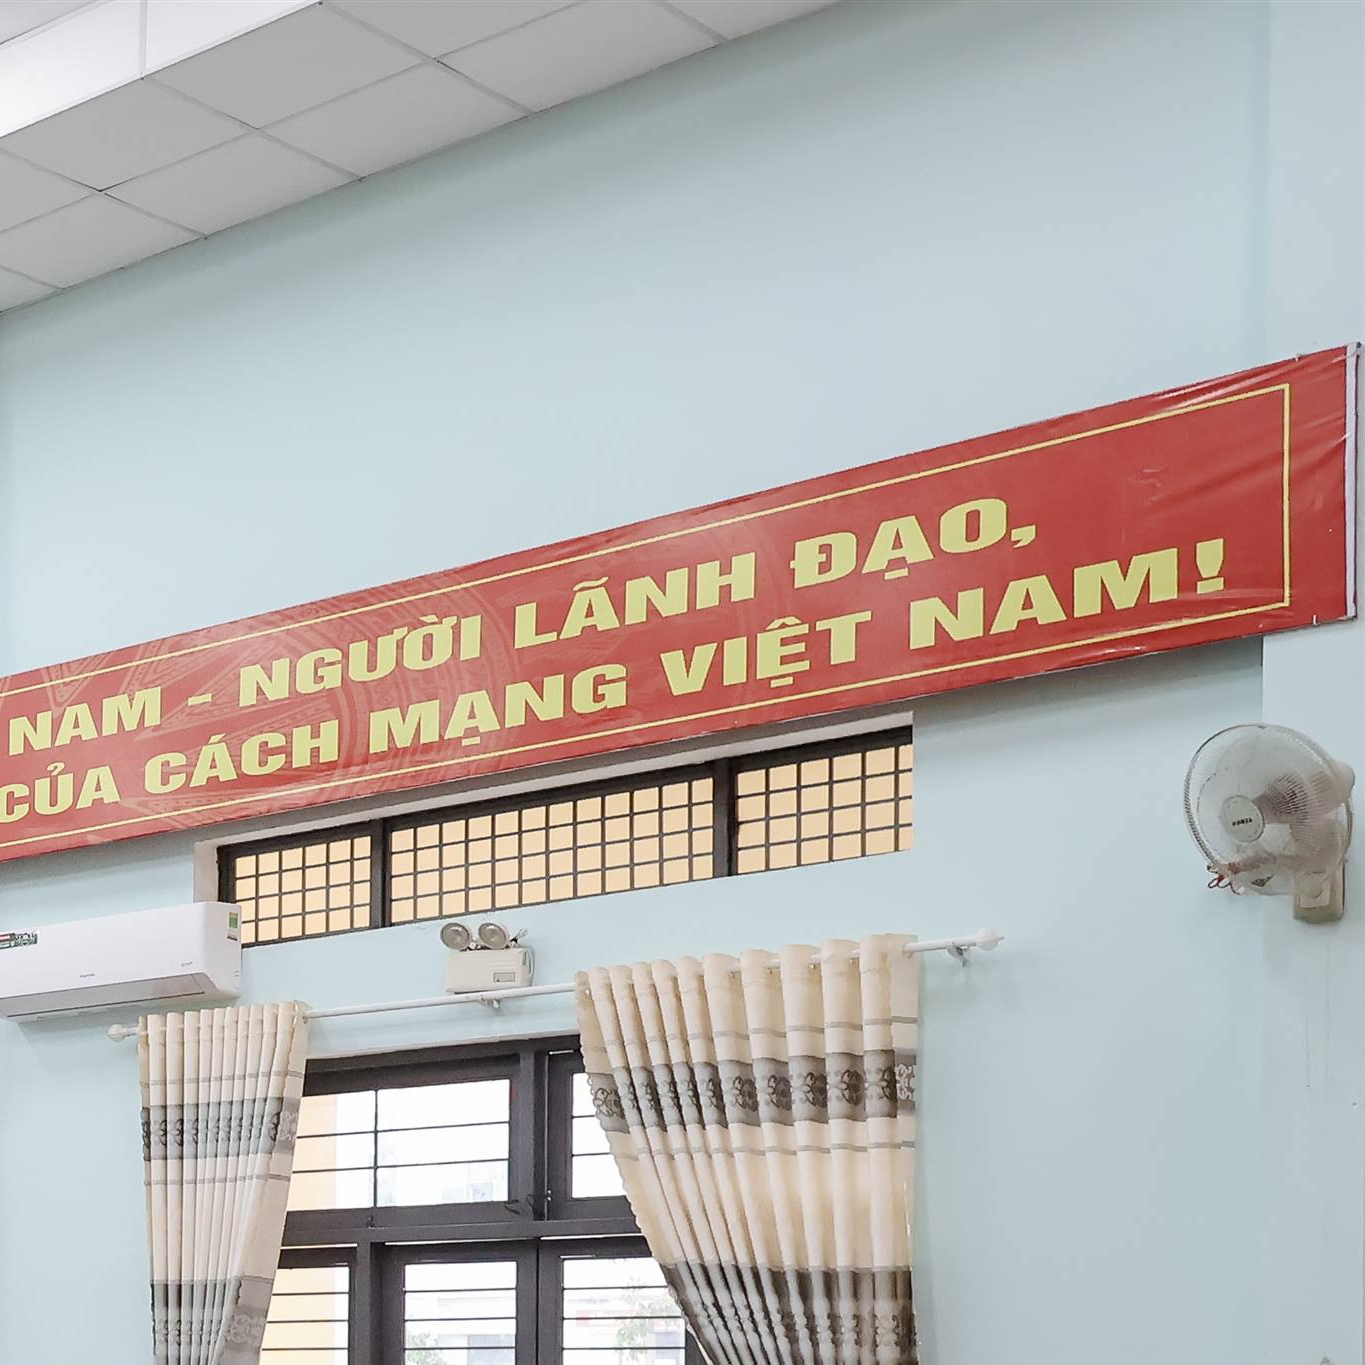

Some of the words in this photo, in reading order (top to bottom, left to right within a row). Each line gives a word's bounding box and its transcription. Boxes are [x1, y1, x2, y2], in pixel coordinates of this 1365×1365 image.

[8, 686, 164, 756] NAM
[186, 692, 214, 706] -
[238, 613, 482, 708] NGƯỜI
[514, 552, 756, 649] LÃNH
[789, 498, 1036, 588] ĐẠO,
[143, 719, 340, 794] CÁCH
[368, 663, 627, 755] MẠNG
[660, 610, 872, 697] VIỆT
